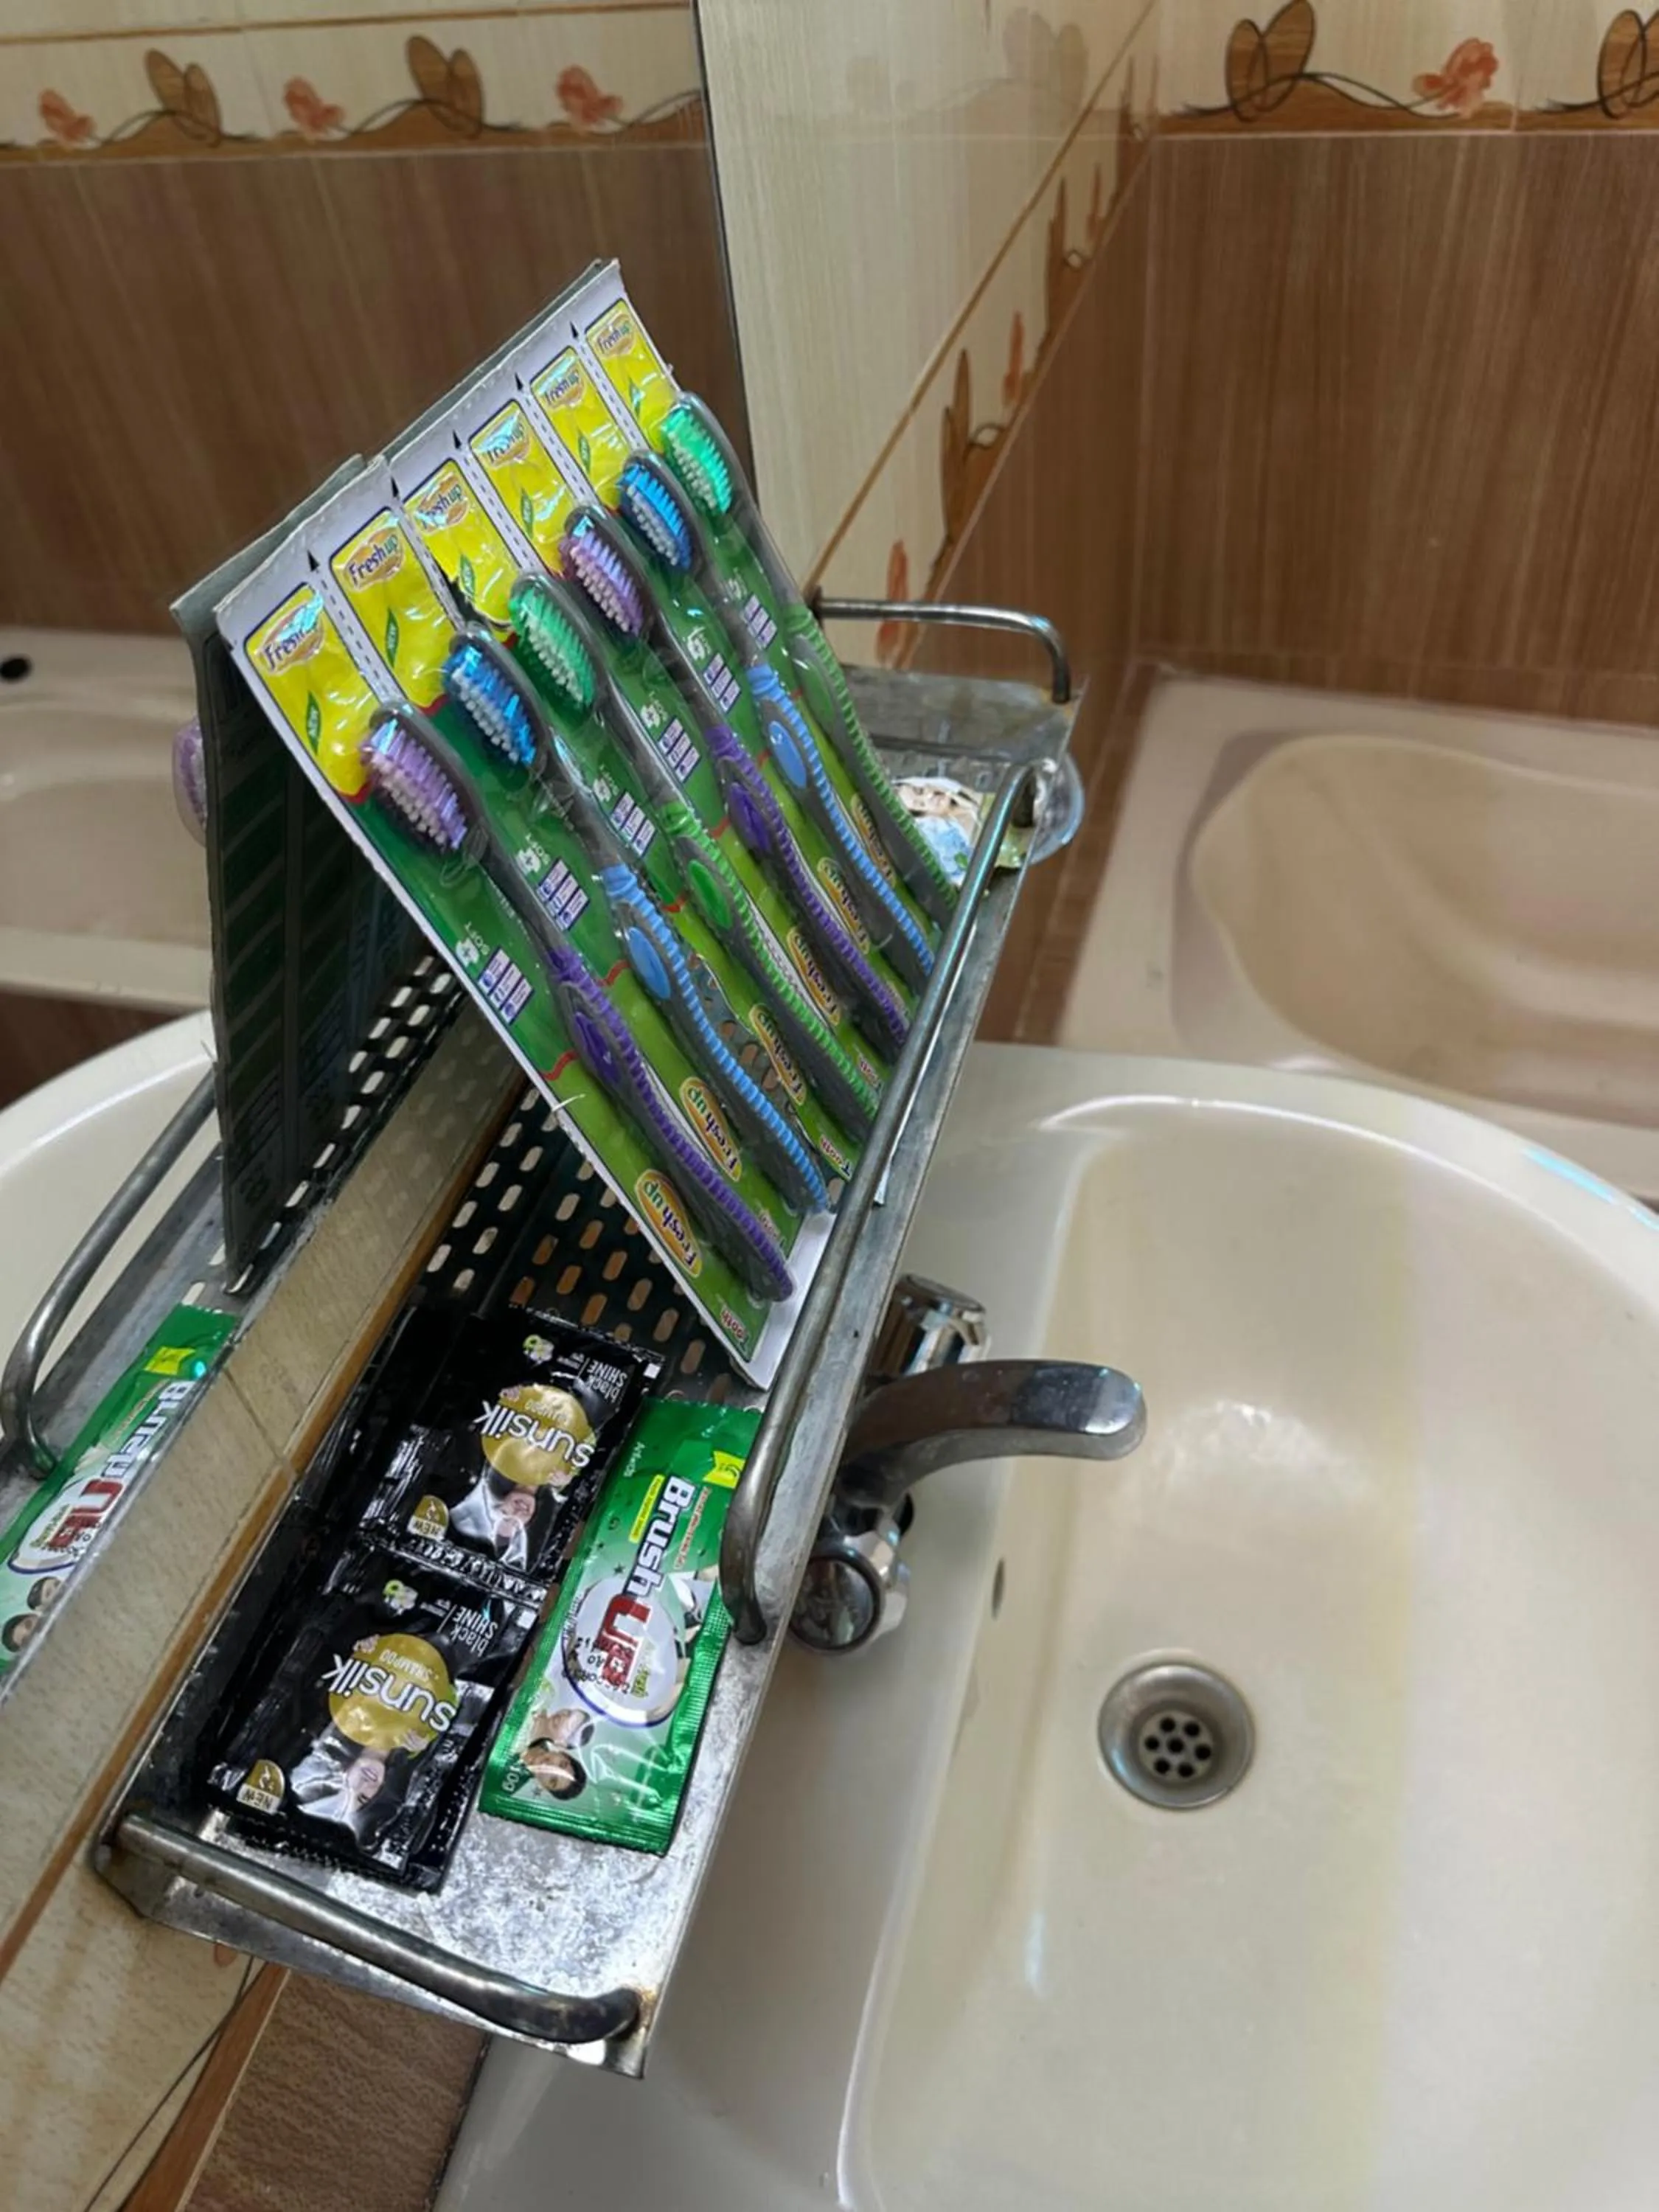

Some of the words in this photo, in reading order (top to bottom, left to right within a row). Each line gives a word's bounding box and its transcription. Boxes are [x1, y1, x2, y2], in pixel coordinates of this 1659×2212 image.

[349, 543, 386, 586] Fresh
[705, 1112, 738, 1169] Fresh
[661, 1206, 698, 1265] Fresh
[587, 1358, 629, 1390] SHINE
[473, 1401, 596, 1469] sunsilk
[626, 1475, 695, 1598] Brush
[451, 1622, 490, 1657] black
[452, 1605, 499, 1641] SHINE
[321, 1654, 456, 1733] sunsilk
[244, 1787, 274, 1811] NEW
